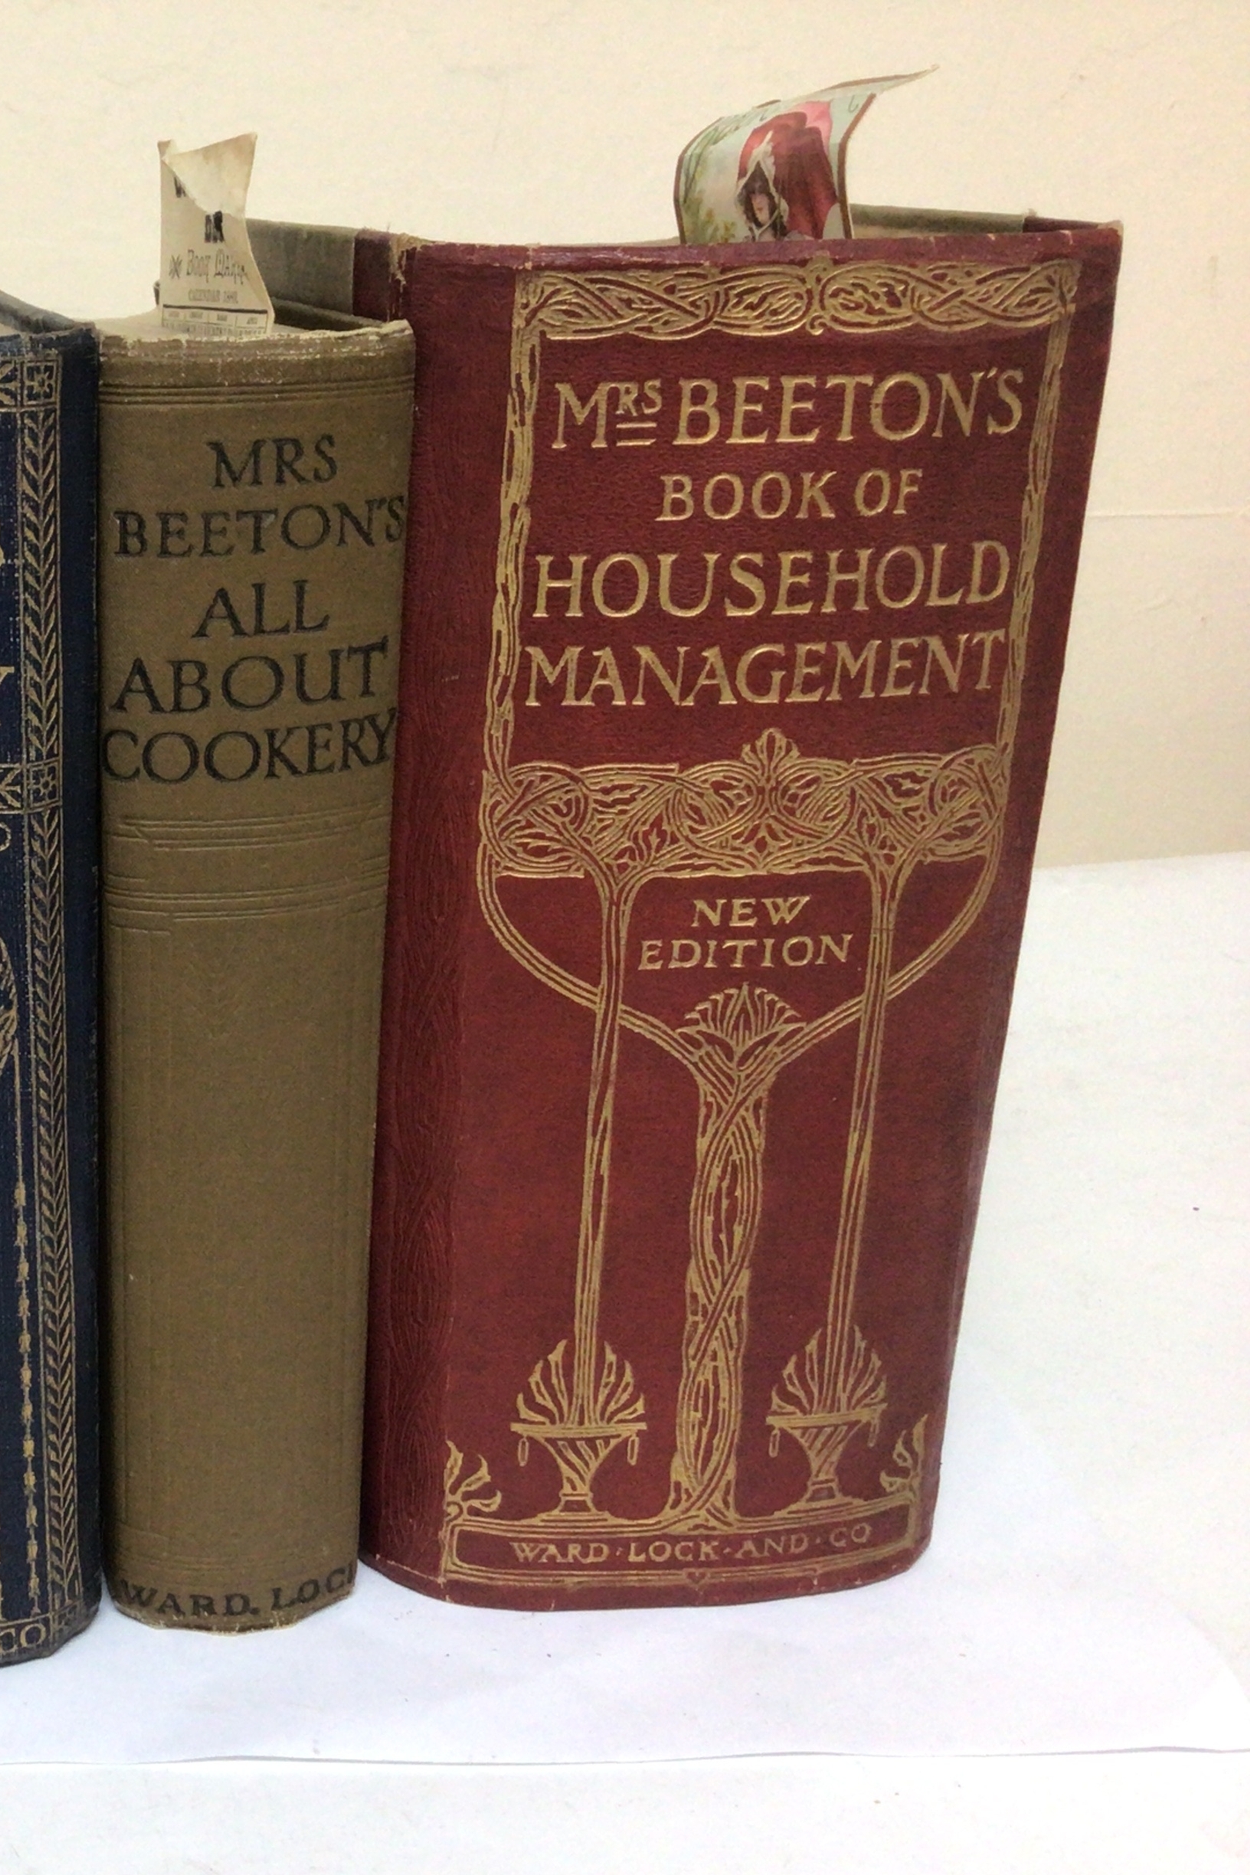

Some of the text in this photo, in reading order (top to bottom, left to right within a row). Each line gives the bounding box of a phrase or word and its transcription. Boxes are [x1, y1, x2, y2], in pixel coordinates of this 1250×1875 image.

[551, 368, 1024, 449] MRS BEETON'S
[206, 433, 338, 488] MRS
[655, 467, 923, 521] BOOK OF
[113, 495, 405, 559] BEETON'S
[532, 539, 1011, 618] HOUSEHOLD
[191, 579, 330, 639] ALL
[110, 635, 390, 714] ABOUT
[524, 628, 1006, 707] MANAGEMENT
[101, 706, 398, 784] COOKERY
[691, 895, 811, 928] NEW
[638, 933, 854, 970] EDITION
[509, 1540, 609, 1564] WARD
[628, 1538, 721, 1563] LOCK
[734, 1532, 809, 1562] AND
[270, 1563, 356, 1611] LOC
